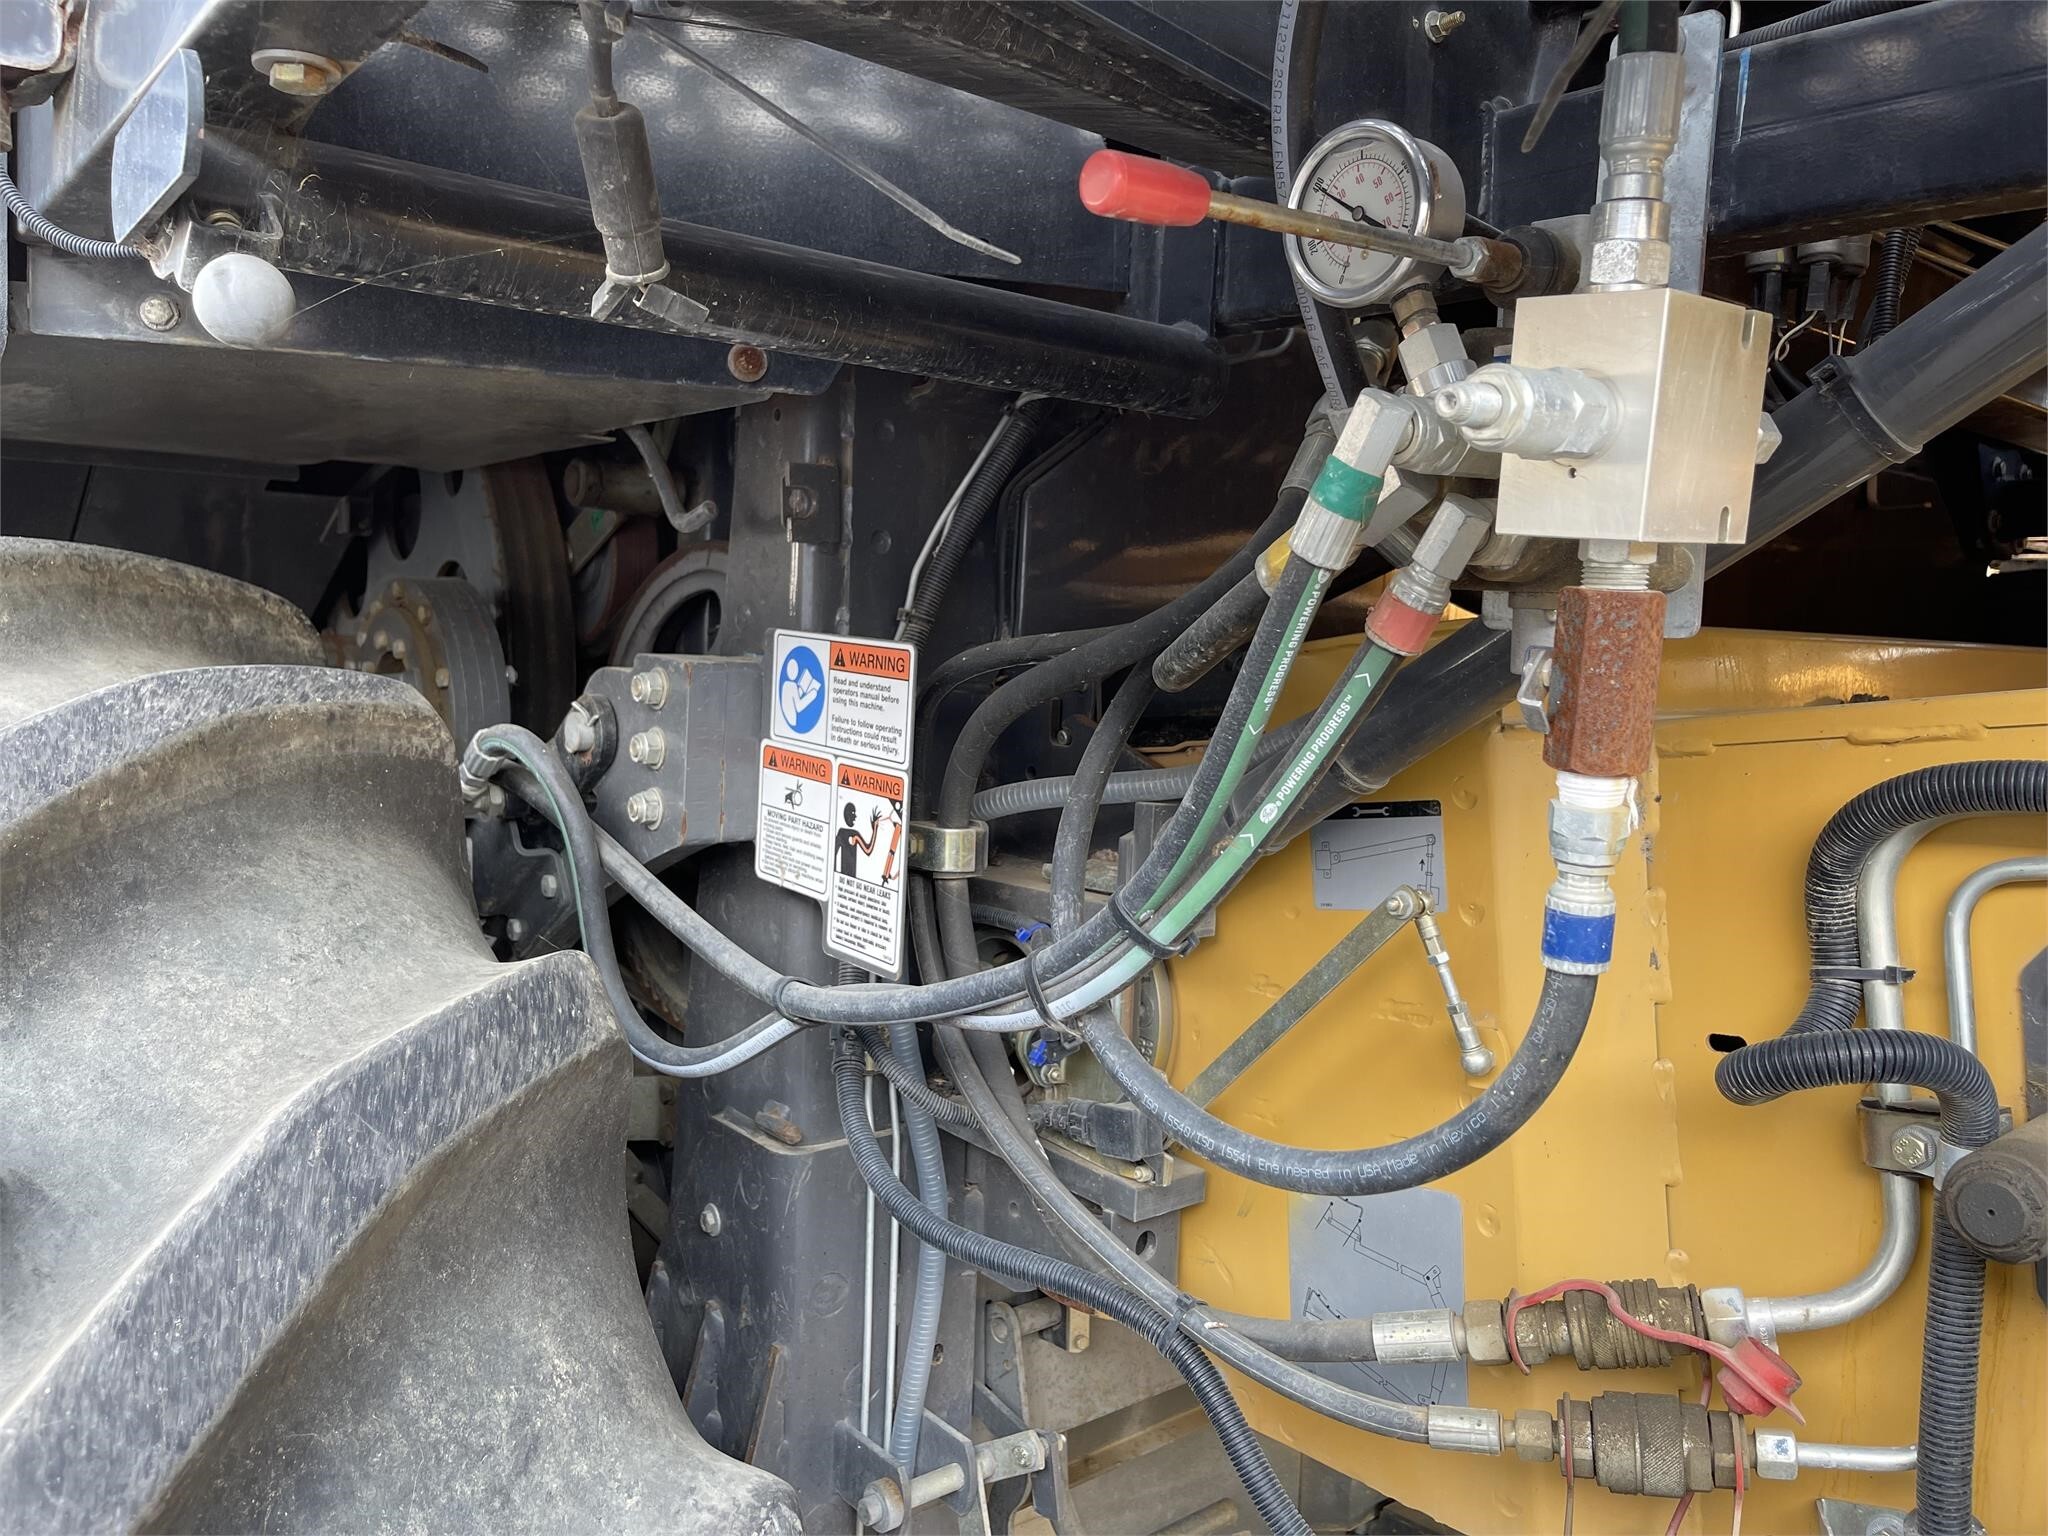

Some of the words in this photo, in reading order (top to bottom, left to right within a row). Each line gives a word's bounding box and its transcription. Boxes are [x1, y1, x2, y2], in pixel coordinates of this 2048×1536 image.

[1276, 13, 1290, 64] 11237
[1273, 69, 1284, 100] 2SC
[1272, 104, 1282, 134] R16
[1274, 151, 1287, 199] EN857
[1312, 177, 1324, 194] 400
[1355, 173, 1365, 185] 40
[1372, 176, 1383, 189] 50
[1336, 188, 1346, 200] 30
[1384, 192, 1394, 206] 60
[1308, 240, 1319, 256] 200
[1312, 345, 1329, 370] SAE
[1288, 591, 1320, 649] POWERING
[849, 650, 905, 673] WARNING
[832, 687, 858, 698] operators
[860, 692, 880, 701] manual
[881, 694, 900, 704] before
[833, 676, 847, 686] Read
[848, 680, 858, 688] and
[860, 682, 891, 692] understand
[832, 697, 847, 706] using
[848, 698, 858, 707] this
[860, 702, 885, 711] machine.
[832, 714, 849, 725] Failure
[858, 720, 874, 729] follow
[875, 724, 903, 737] operating
[832, 724, 863, 737] instructions
[864, 731, 880, 741] could
[880, 735, 898, 744] result
[837, 735, 852, 744] death
[860, 741, 881, 751] serious
[882, 744, 900, 756] injury.
[780, 754, 826, 778] WARNING
[1276, 750, 1316, 801] POWERING
[853, 773, 901, 796] WARNING
[768, 810, 787, 821] MOVING
[788, 815, 801, 825] PART
[802, 821, 824, 832] HAZARD
[839, 875, 845, 884] DO
[847, 878, 855, 888] NOT
[856, 881, 862, 890] GO
[863, 884, 875, 895] NEAR
[876, 889, 891, 900] LEAKS
[1114, 1064, 1138, 1096] Meets
[1142, 1093, 1159, 1114] ISO
[1162, 1111, 1215, 1150] 15540/ISO
[1221, 1144, 1251, 1167] 15541
[1258, 1158, 1329, 1179] Engineered
[1338, 1168, 1352, 1180] in
[1386, 1152, 1419, 1174] Made
[1424, 1142, 1440, 1158] in
